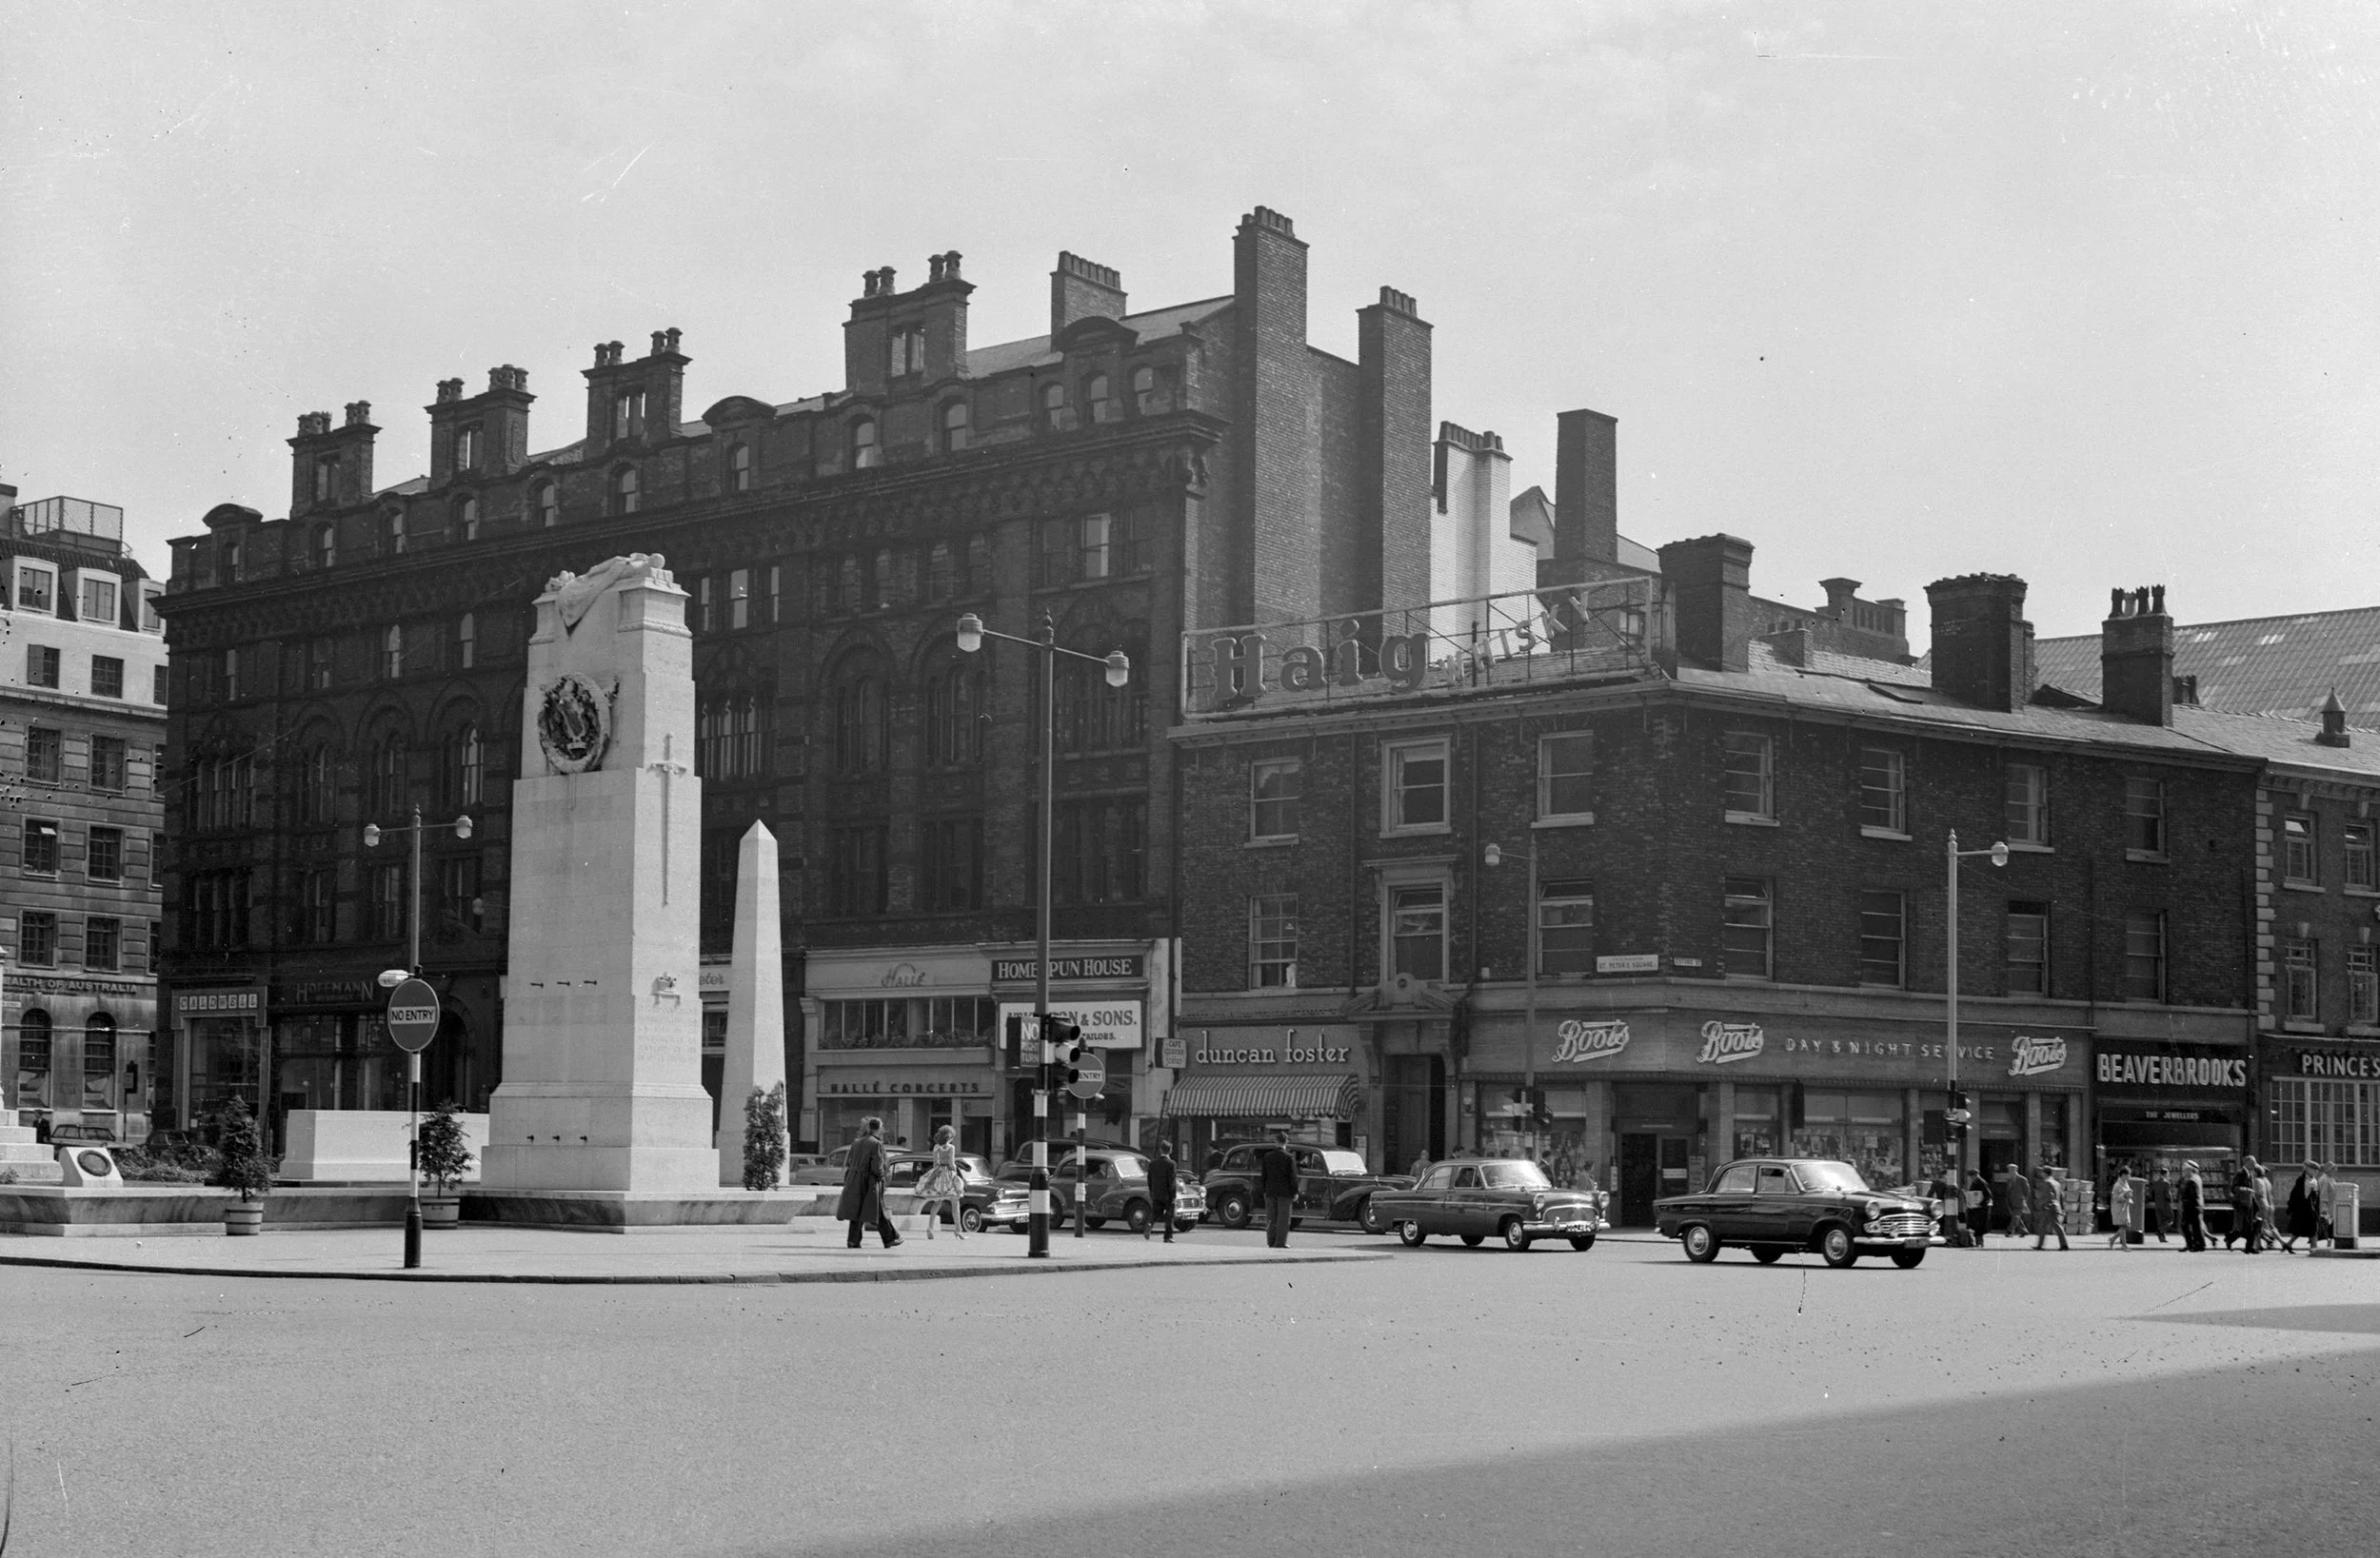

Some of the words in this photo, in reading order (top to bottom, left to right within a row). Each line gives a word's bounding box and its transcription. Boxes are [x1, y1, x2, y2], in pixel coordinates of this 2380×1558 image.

[1212, 619, 1429, 701] Haig
[1438, 591, 1590, 685] WHISKY
[998, 960, 1081, 978] HOMEPUN
[1083, 958, 1133, 976] HOUSE
[48, 979, 65, 990] OF
[69, 980, 138, 993] AUSTRALIA
[179, 994, 257, 1010] CALDWELL
[391, 1011, 405, 1021] NO
[407, 1010, 434, 1021] ENTRY
[1081, 1014, 1090, 1026] &
[1092, 1010, 1137, 1026] SONS.
[1021, 1022, 1040, 1040] NO
[1196, 1030, 1276, 1063] duncan
[1285, 1028, 1349, 1063] foster
[1551, 1019, 1630, 1063] Boots
[1696, 1020, 1764, 1064] Boots
[1785, 1038, 1821, 1053] DAY
[1832, 1040, 1842, 1054] &
[1849, 1041, 1912, 1055] NIGHT
[2008, 1035, 2068, 1076] Boots
[2097, 1054, 2247, 1087] BEAVERBROOKS
[830, 1080, 880, 1094] HALLÉ
[889, 1082, 979, 1094] CONCERTS
